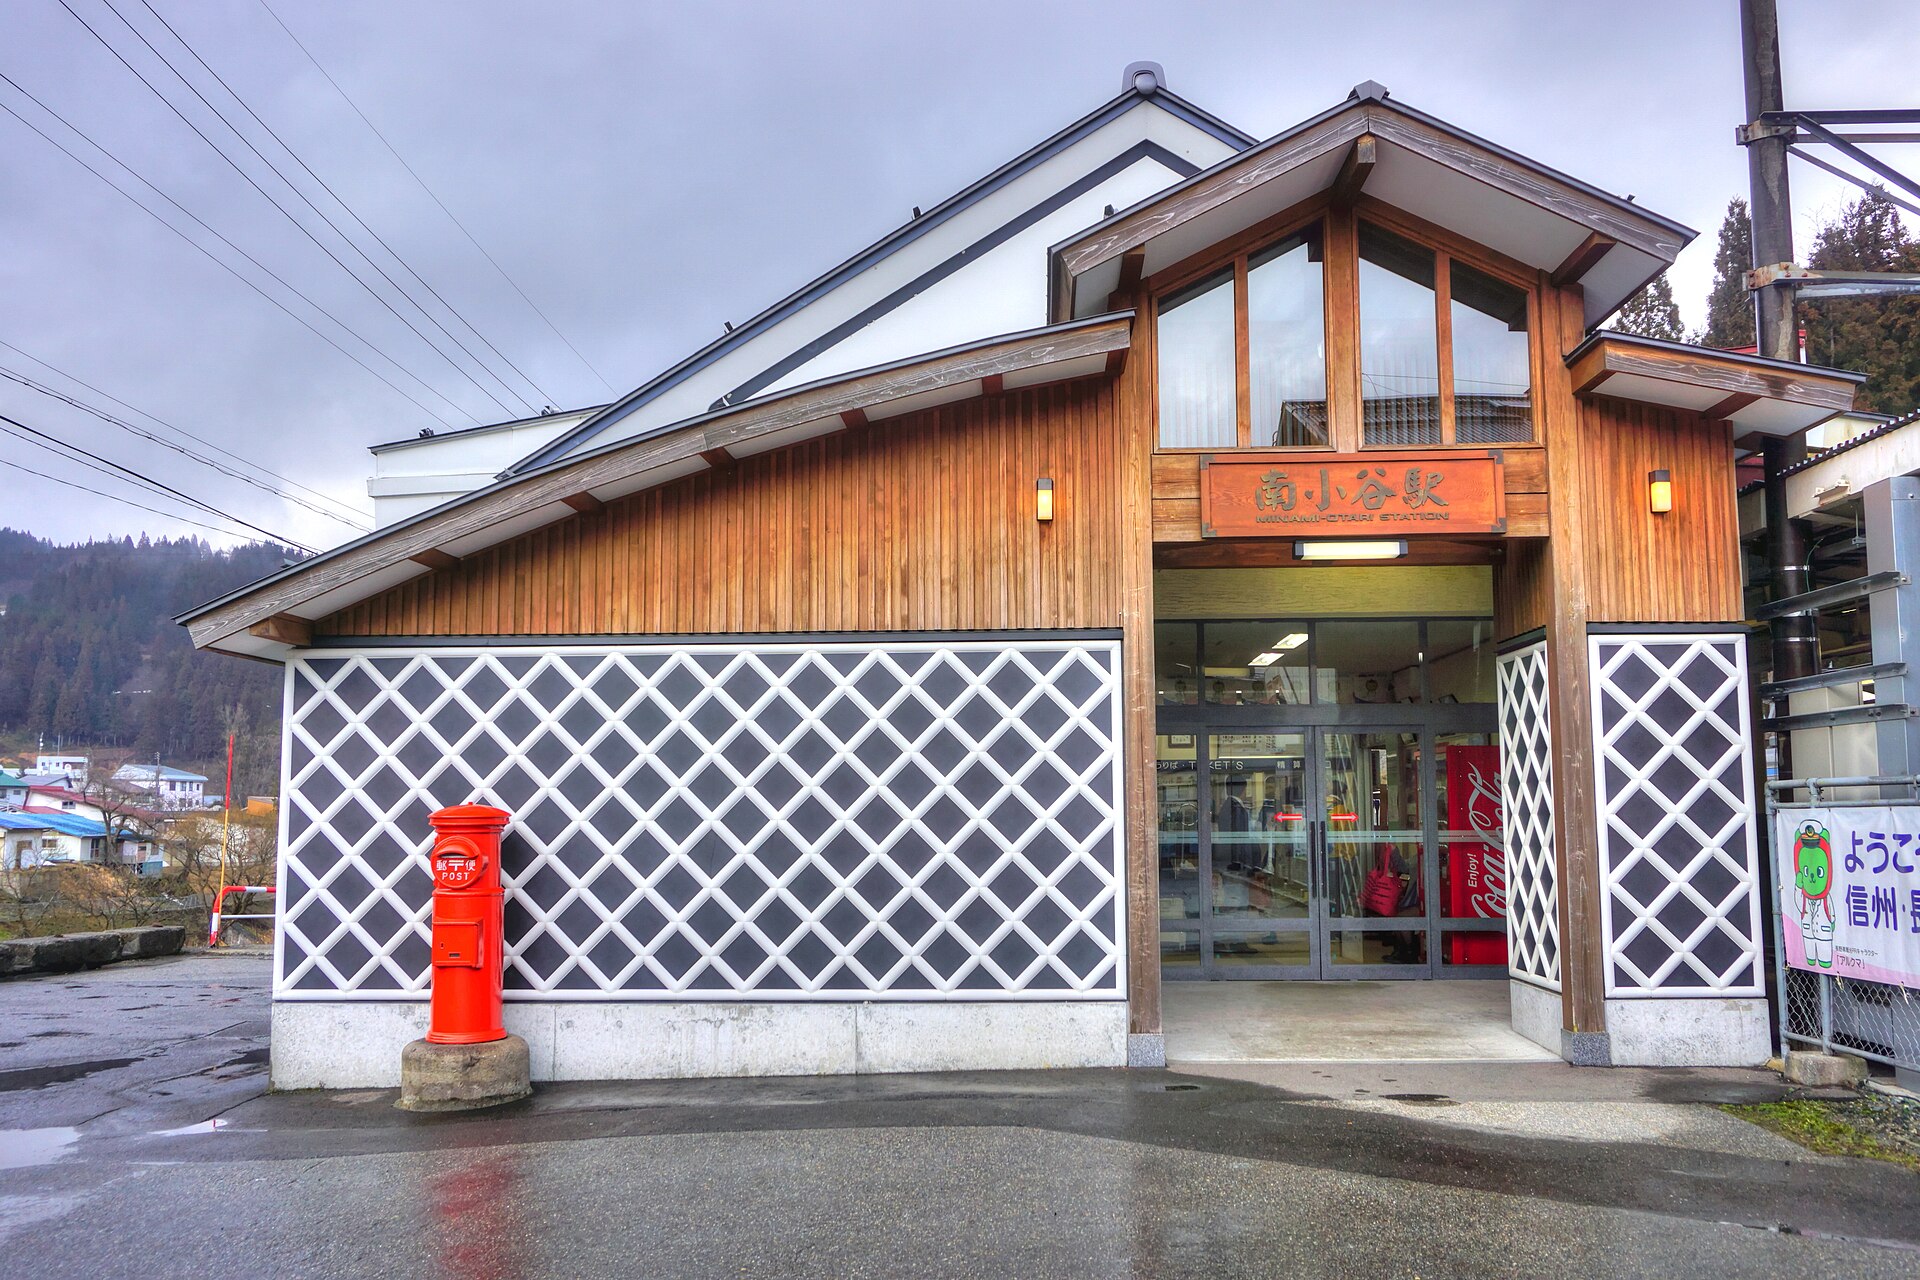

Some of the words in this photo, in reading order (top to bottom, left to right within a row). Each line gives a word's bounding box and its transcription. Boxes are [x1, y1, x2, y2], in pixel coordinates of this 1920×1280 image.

[1254, 467, 1449, 511] 南小谷駅
[1256, 513, 1373, 524] MINAMI-OTARI
[1379, 511, 1450, 523] STATION
[1188, 760, 1244, 770] TKET'S
[1845, 830, 1920, 874] ようこ
[442, 872, 470, 881] POST
[1467, 853, 1479, 888] Enjoy!
